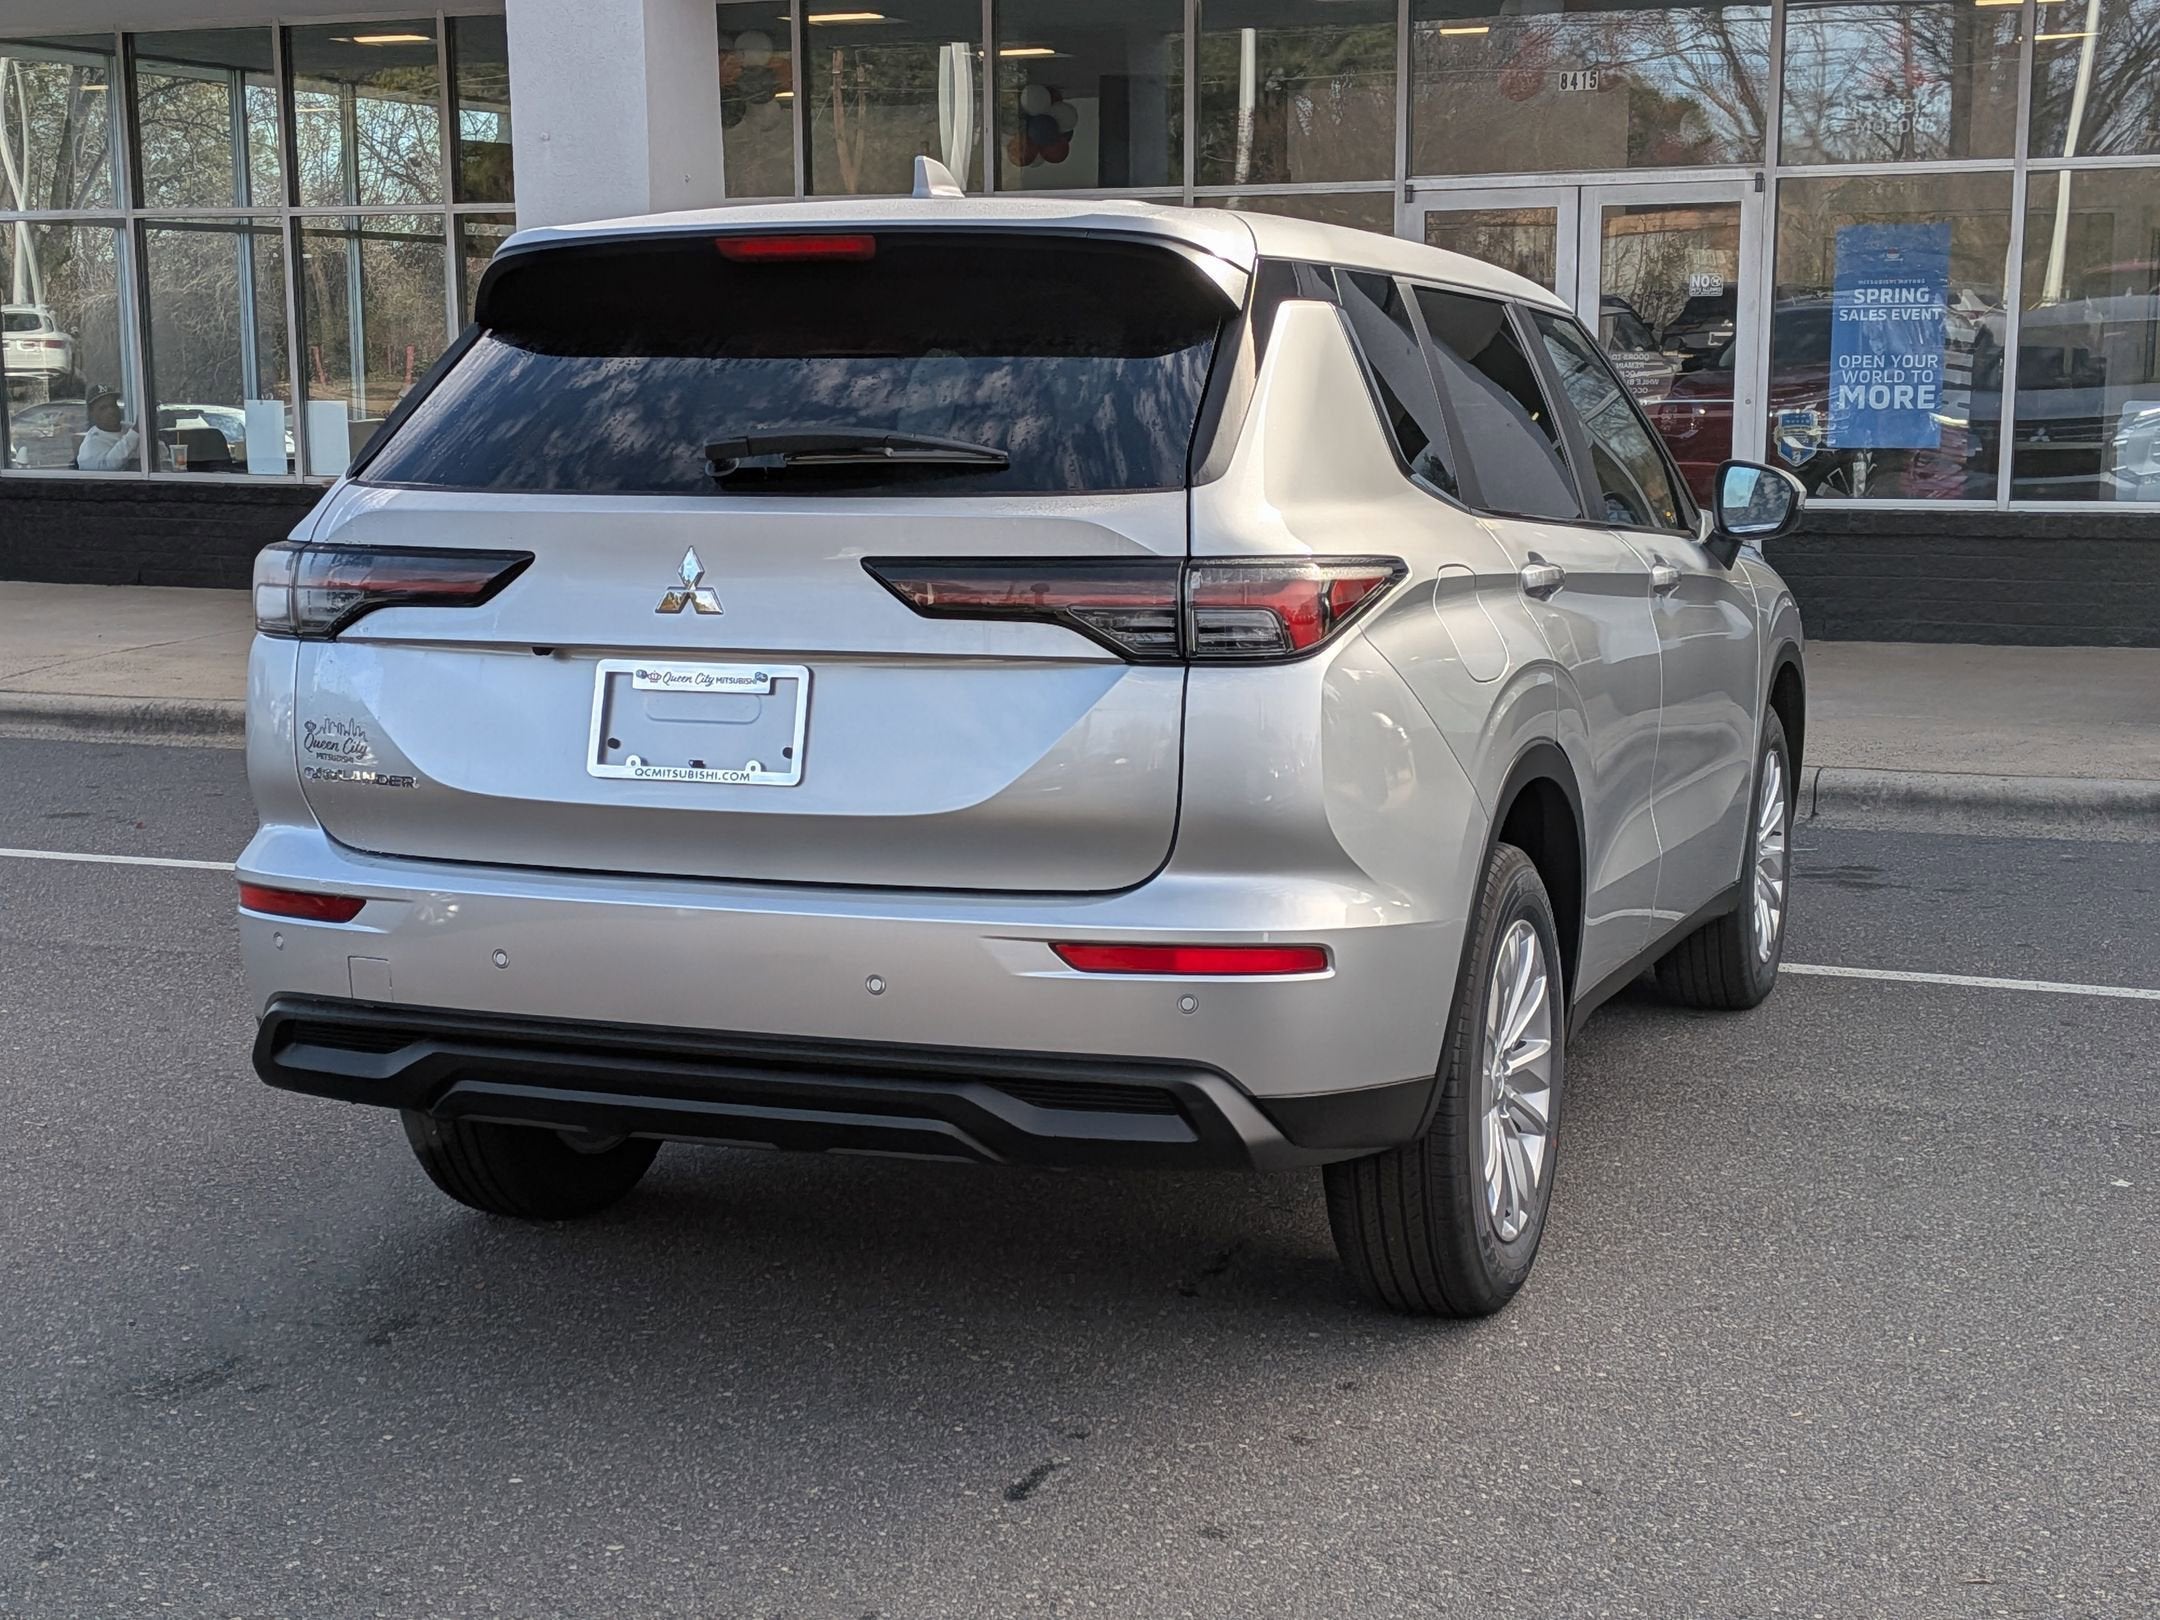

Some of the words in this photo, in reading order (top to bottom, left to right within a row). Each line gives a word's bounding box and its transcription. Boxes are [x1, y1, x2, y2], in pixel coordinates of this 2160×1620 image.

[1560, 71, 1597, 90] 8415
[1691, 275, 1710, 288] NO
[1853, 287, 1930, 304] SPRING
[1839, 308, 1887, 322] SALES
[1891, 307, 1941, 321] EVENT
[1838, 354, 1885, 368] OPEN
[1890, 354, 1938, 368] YOUR
[1842, 369, 1905, 383] WORLD
[1911, 369, 1934, 383] TO
[1838, 384, 1936, 410] MORE
[662, 671, 692, 686] Queen
[694, 672, 715, 687] City
[715, 677, 757, 685] MITSUBISHI
[304, 732, 339, 753] Queen
[342, 737, 368, 760] City
[634, 767, 750, 782] QCMITSUBISHI.COM
